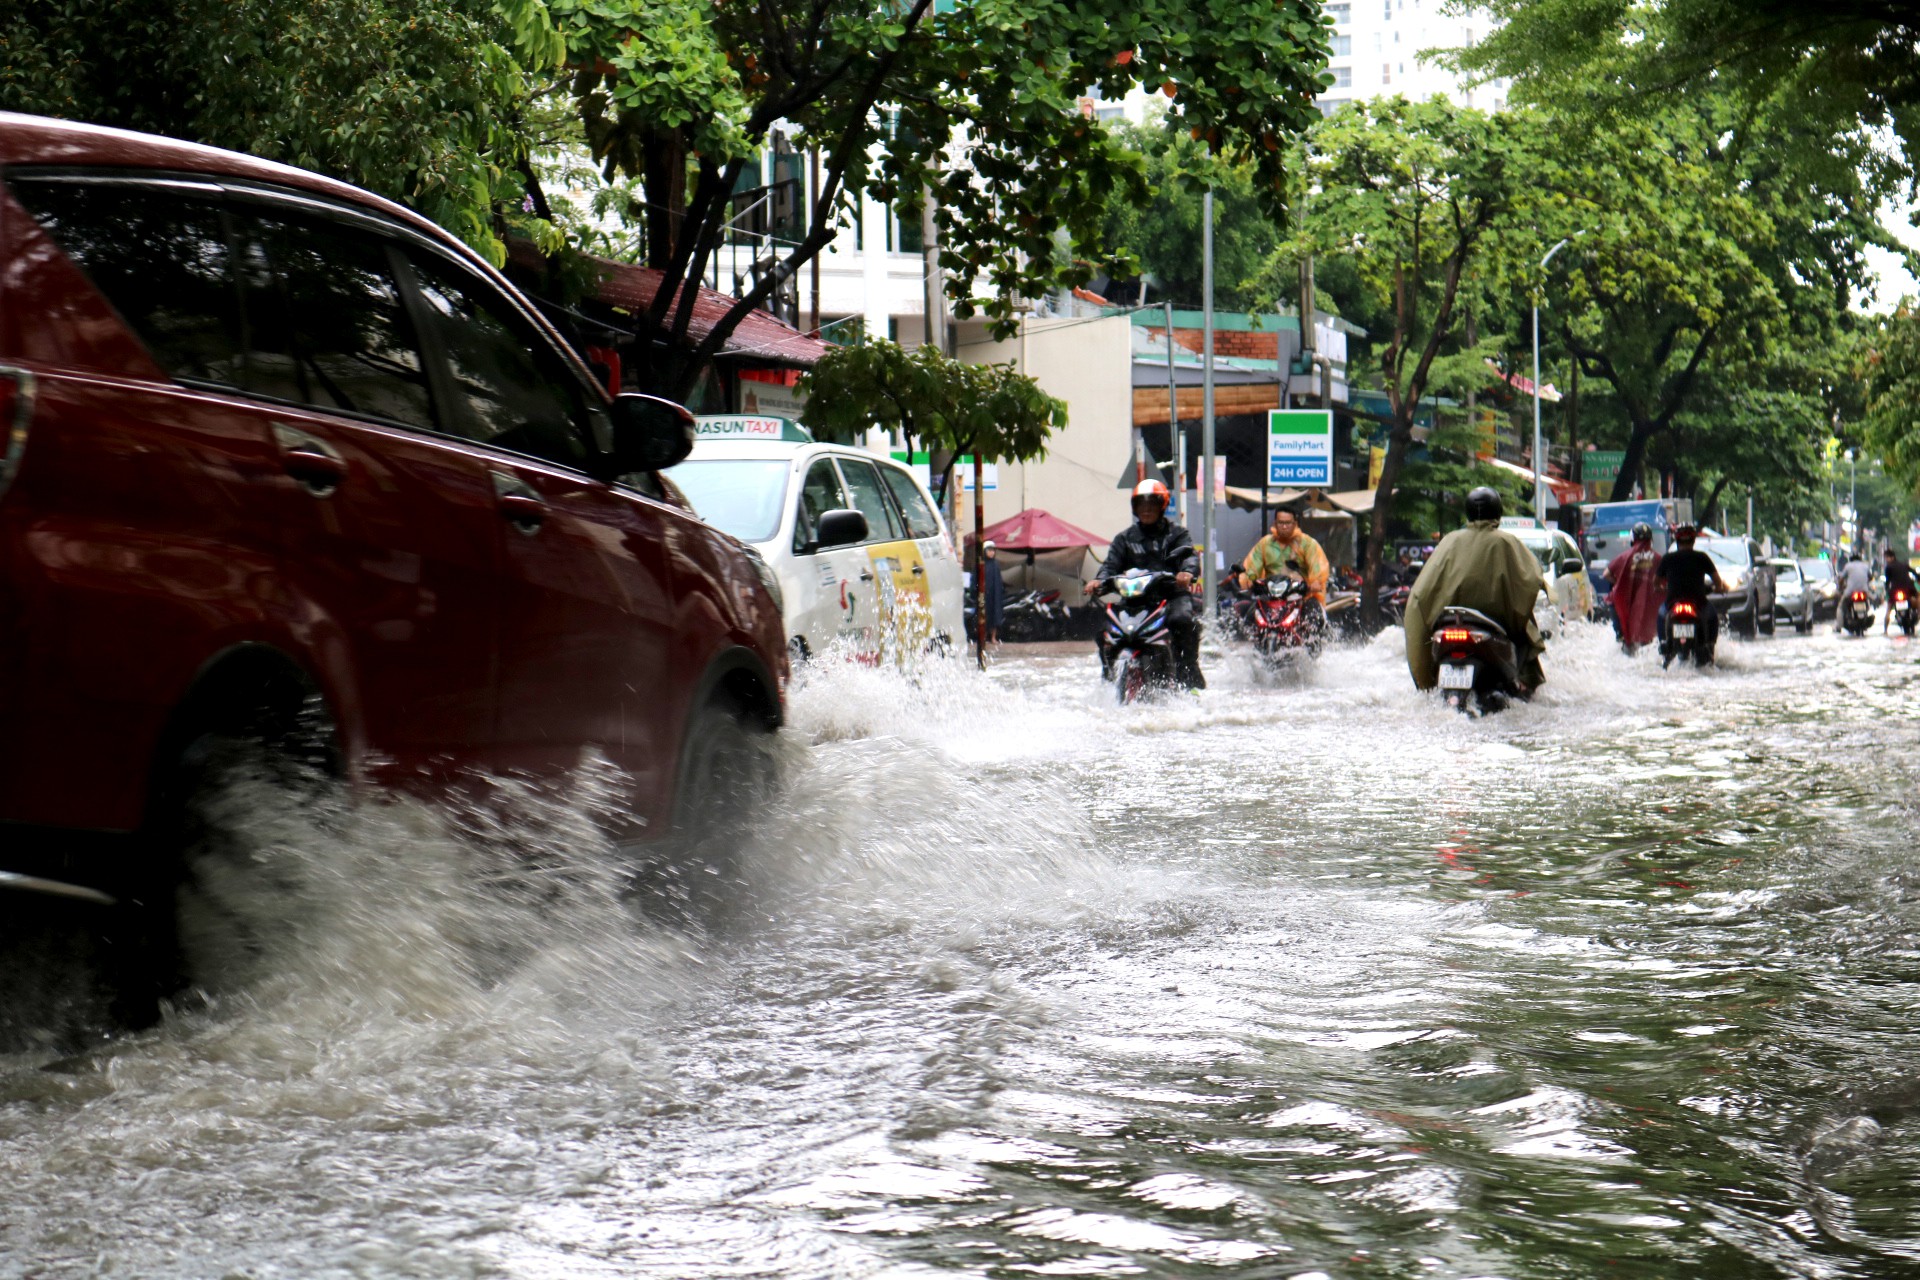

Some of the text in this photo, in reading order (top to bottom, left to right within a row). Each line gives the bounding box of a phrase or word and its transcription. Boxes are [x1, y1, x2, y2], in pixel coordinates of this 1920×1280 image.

[1273, 440, 1324, 451] FamilyMart
[1274, 467, 1324, 479] 24H OPEN
